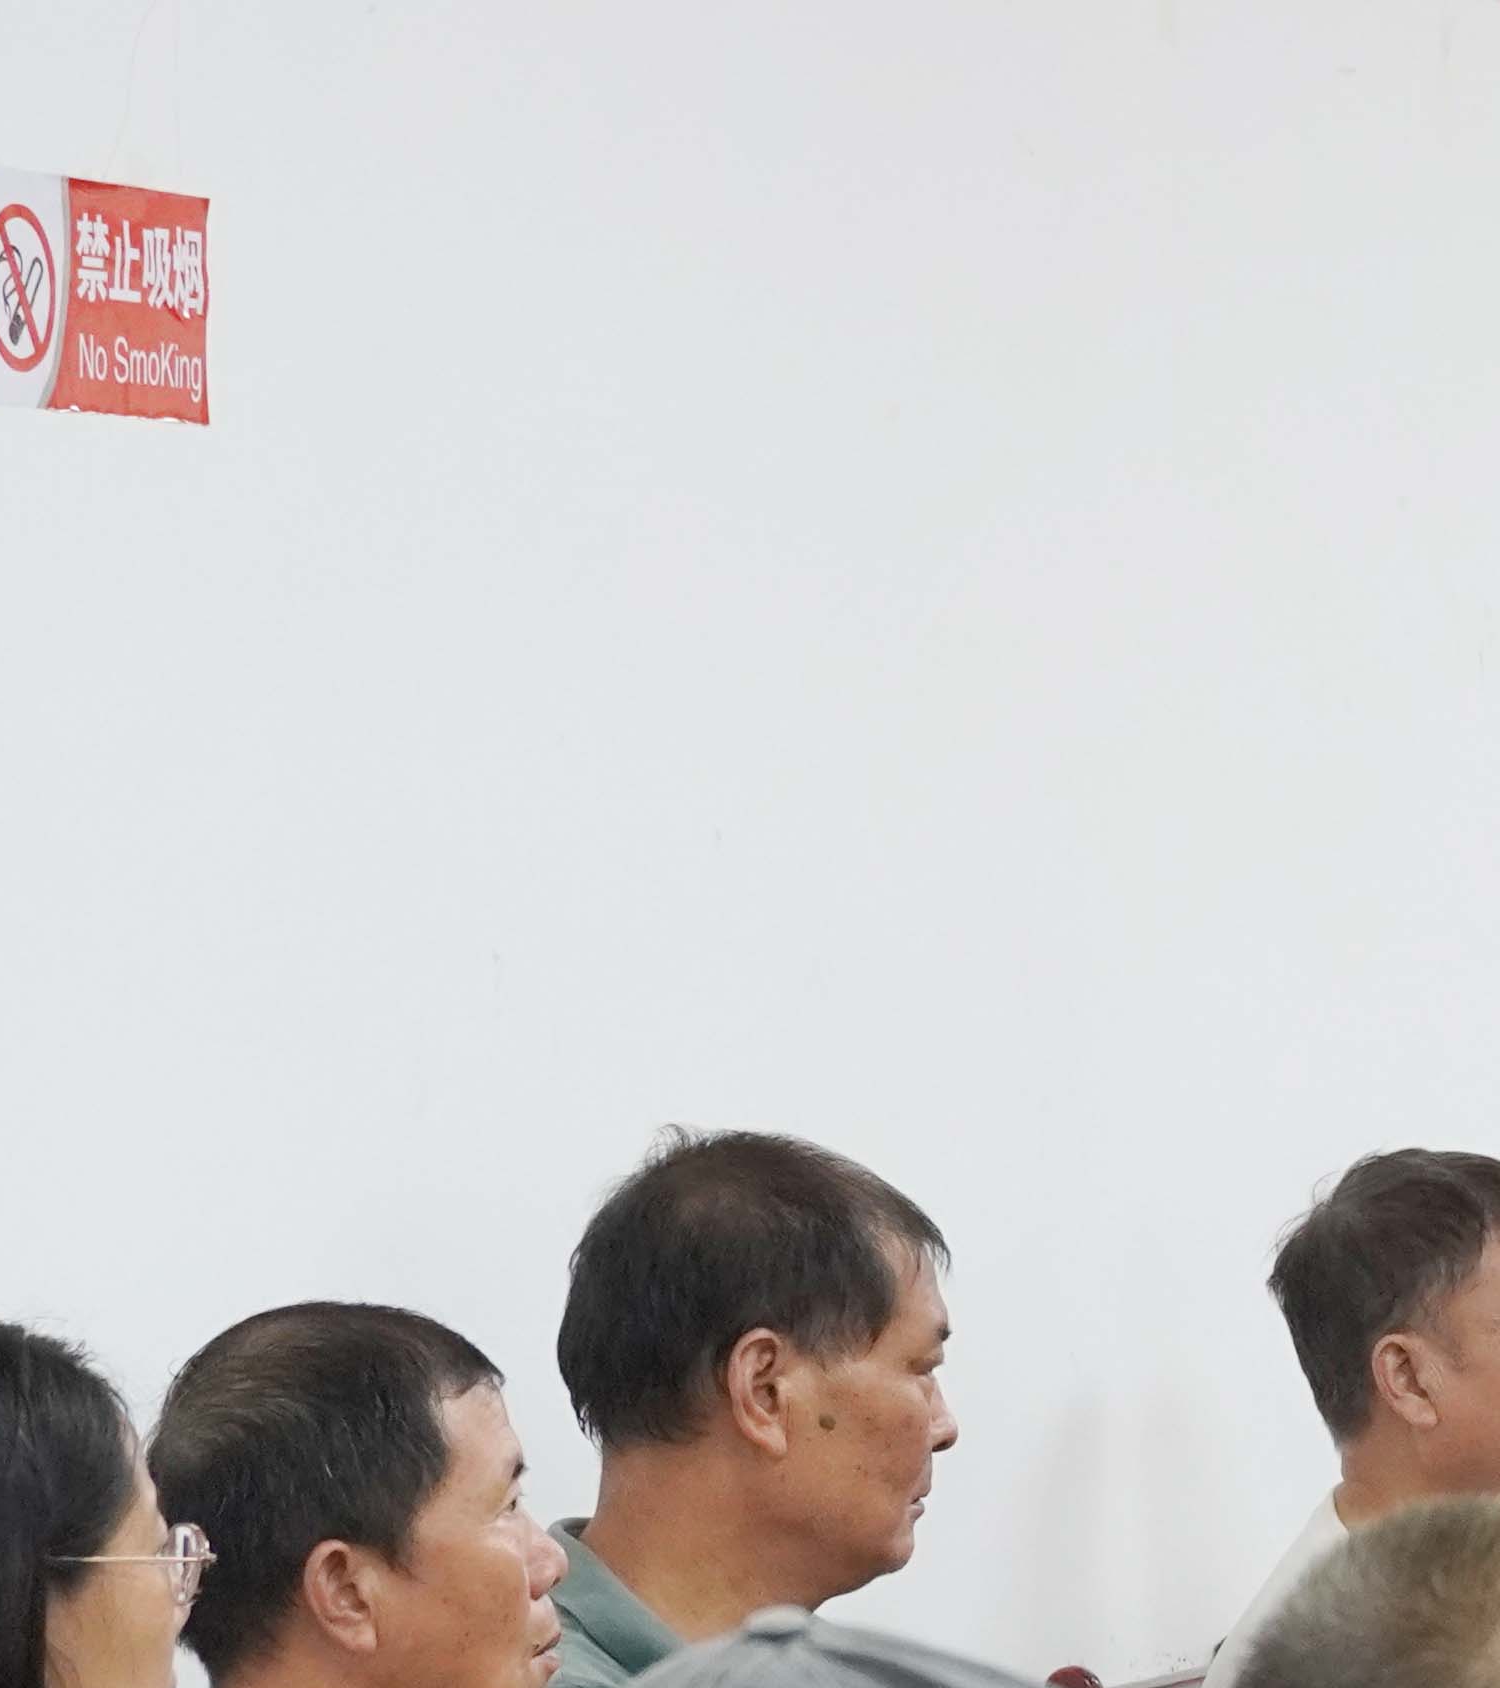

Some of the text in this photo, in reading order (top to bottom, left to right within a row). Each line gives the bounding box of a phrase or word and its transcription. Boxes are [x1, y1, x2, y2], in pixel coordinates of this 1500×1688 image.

[76, 212, 205, 320] 禁止吸烟
[79, 332, 109, 381] No
